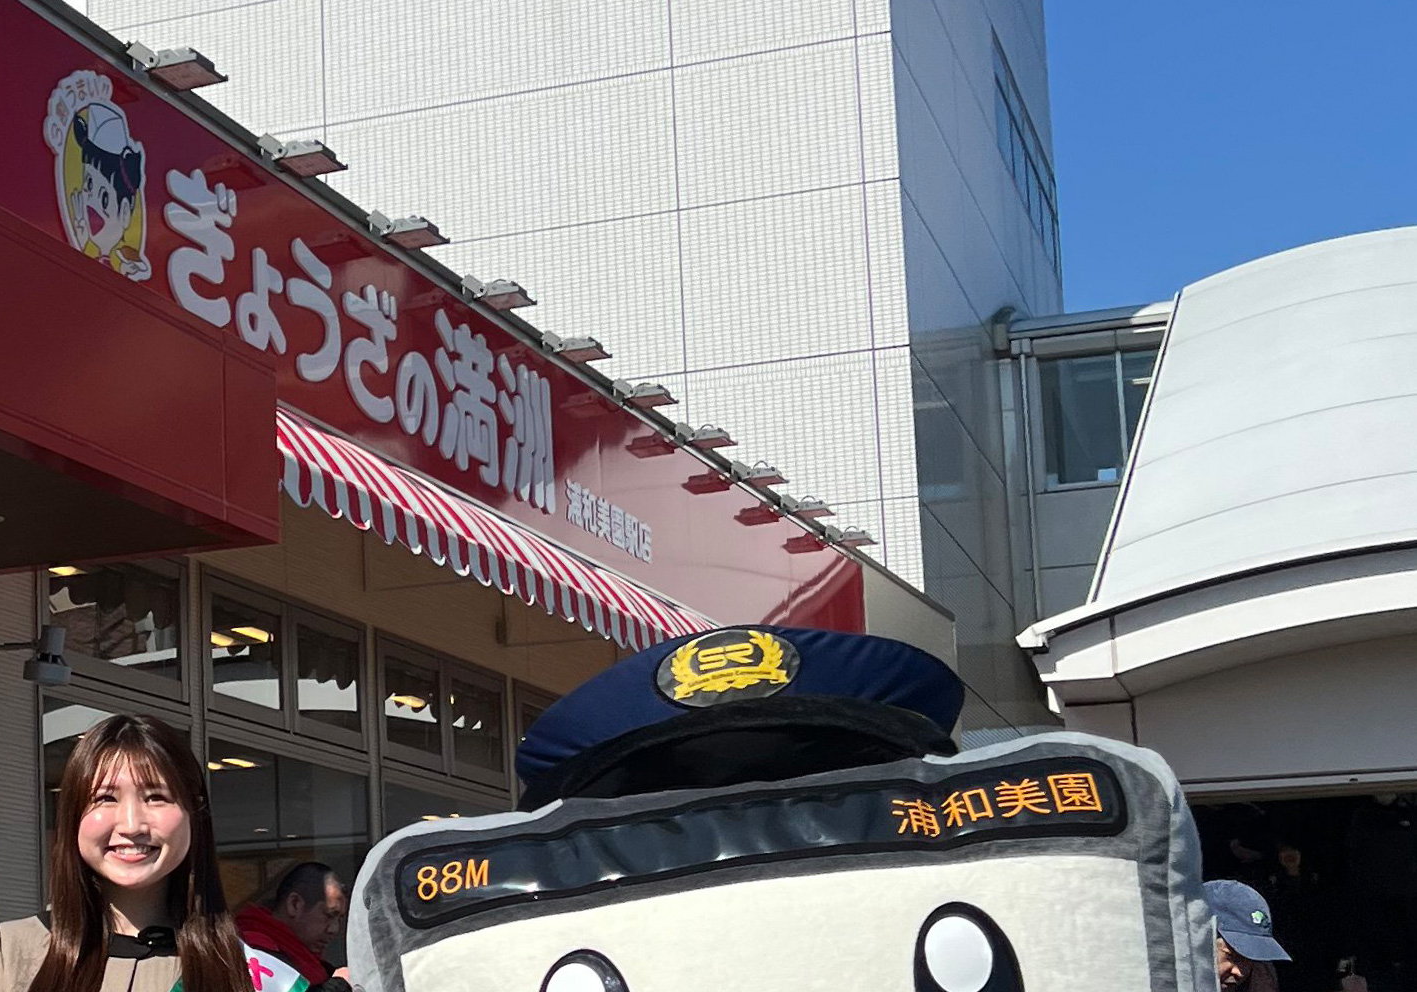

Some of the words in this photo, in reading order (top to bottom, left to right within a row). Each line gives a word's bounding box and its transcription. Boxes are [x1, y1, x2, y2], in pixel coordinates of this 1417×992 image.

[164, 169, 556, 515] ぎょうざの満洲
[697, 642, 754, 671] SR
[892, 773, 1103, 837] 浦和美園
[417, 858, 489, 901] 88M
